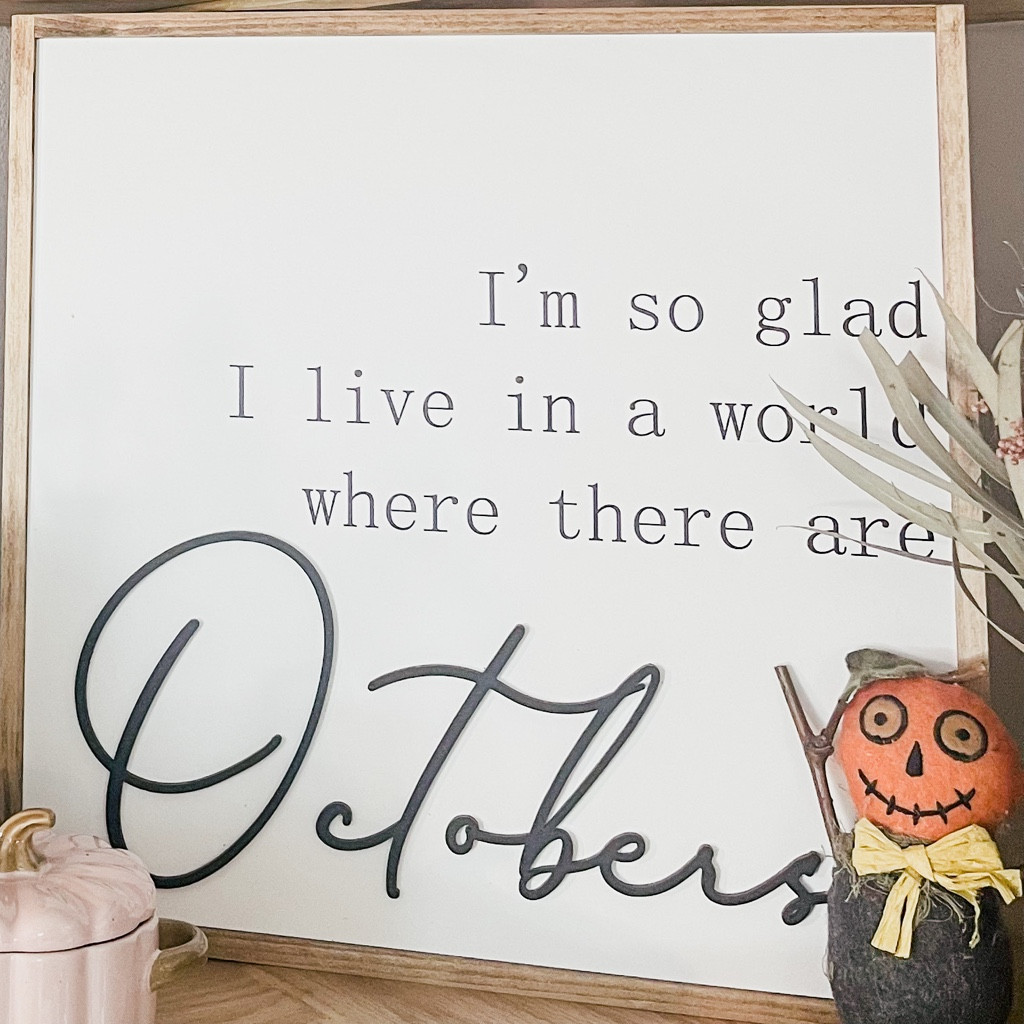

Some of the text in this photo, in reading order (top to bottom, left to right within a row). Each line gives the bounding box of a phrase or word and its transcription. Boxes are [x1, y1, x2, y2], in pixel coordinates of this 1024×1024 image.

[478, 263, 928, 346] I'm so glad
[229, 364, 255, 419] I
[306, 366, 454, 428] live
[507, 376, 581, 433] in
[628, 398, 666, 437] a
[301, 470, 935, 558] where there are
[75, 530, 828, 926] Octobers
